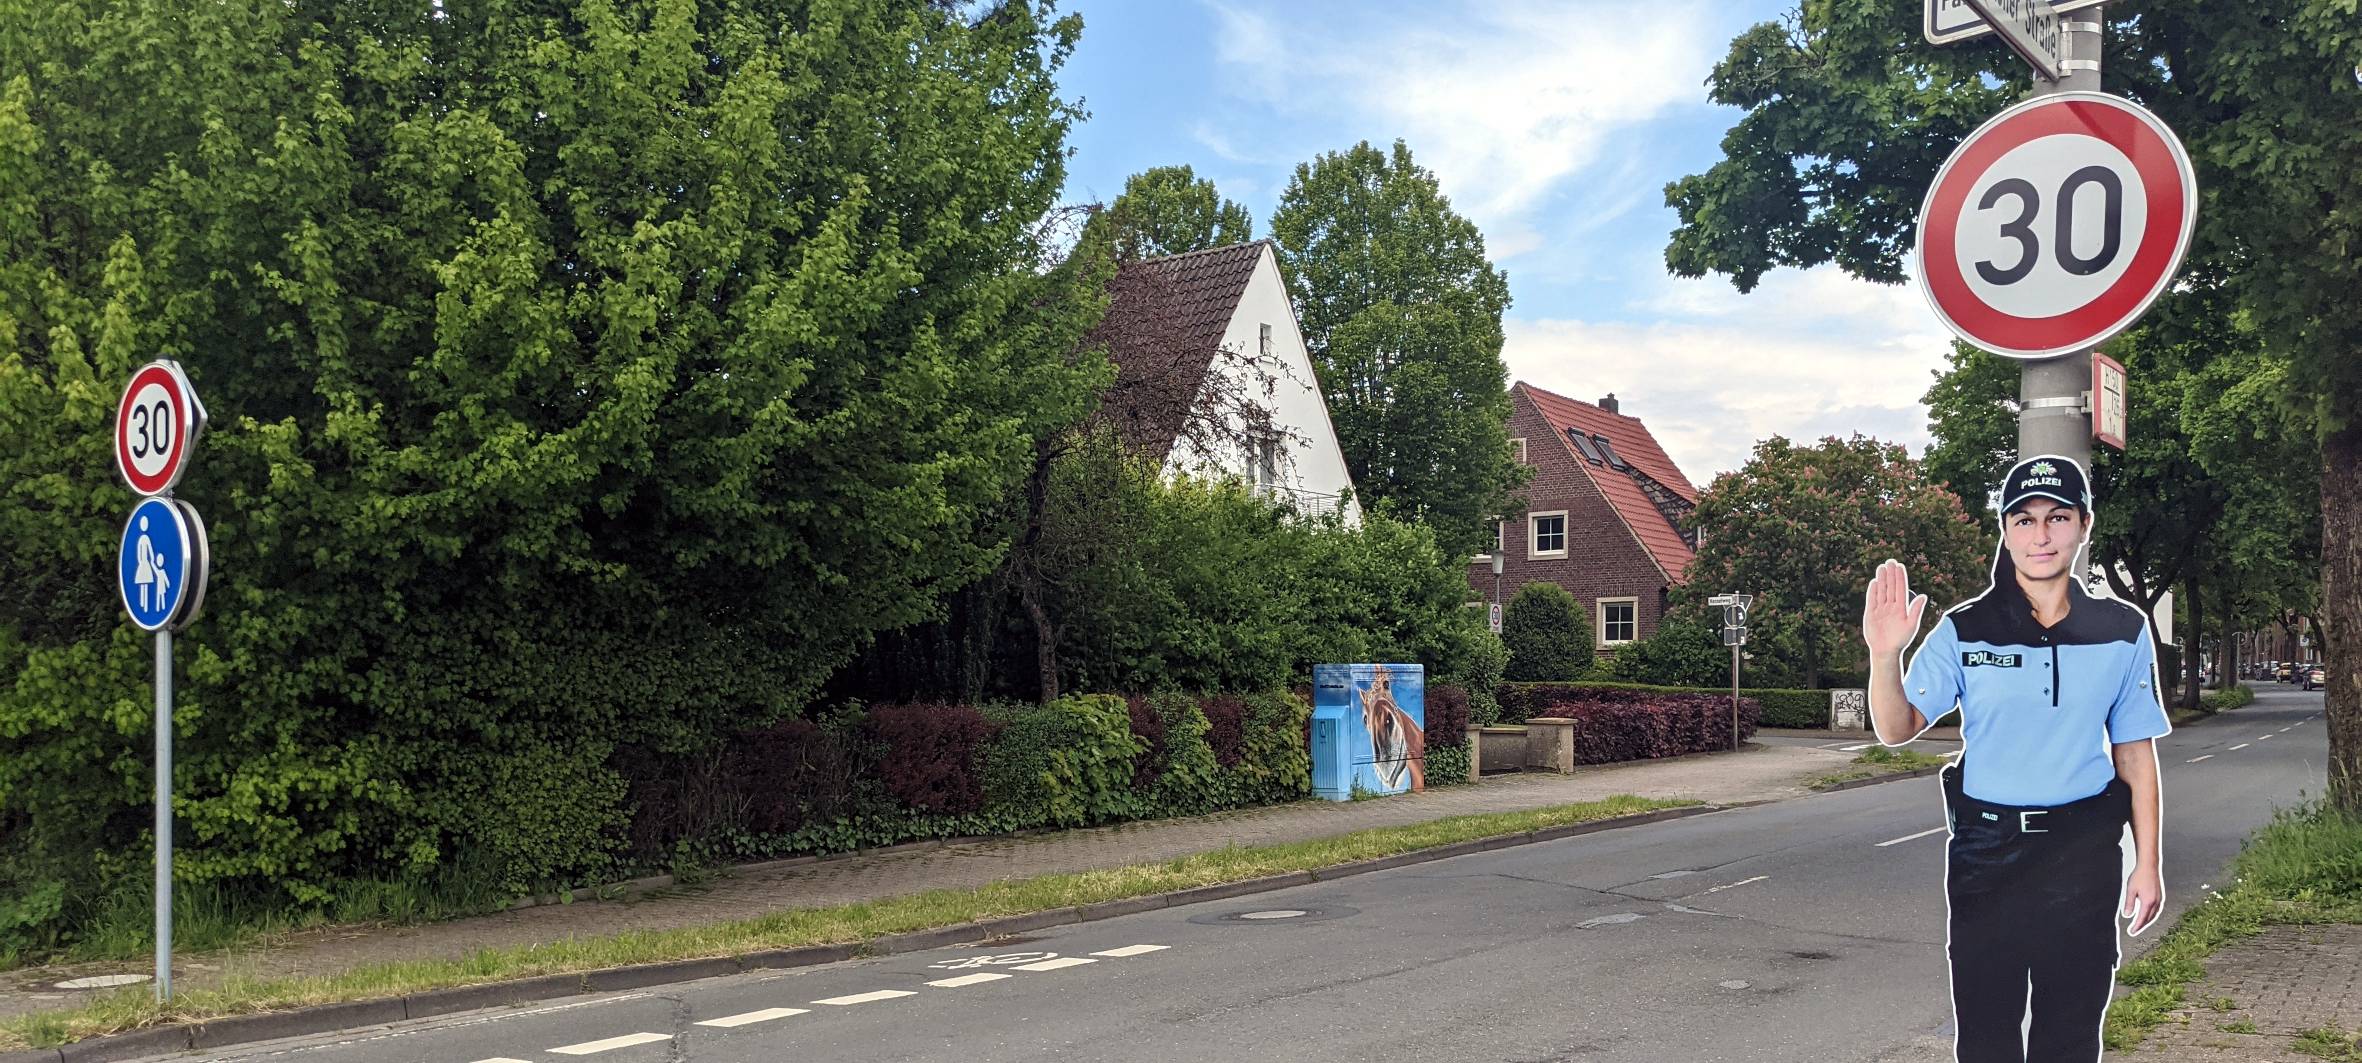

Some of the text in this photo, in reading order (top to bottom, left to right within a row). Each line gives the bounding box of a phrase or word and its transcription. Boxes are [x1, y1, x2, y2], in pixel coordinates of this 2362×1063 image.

[1975, 165, 2123, 286] 30
[132, 400, 170, 459] 30
[2021, 477, 2062, 489] POLIZEI
[1968, 651, 2015, 667] POLIZEI
